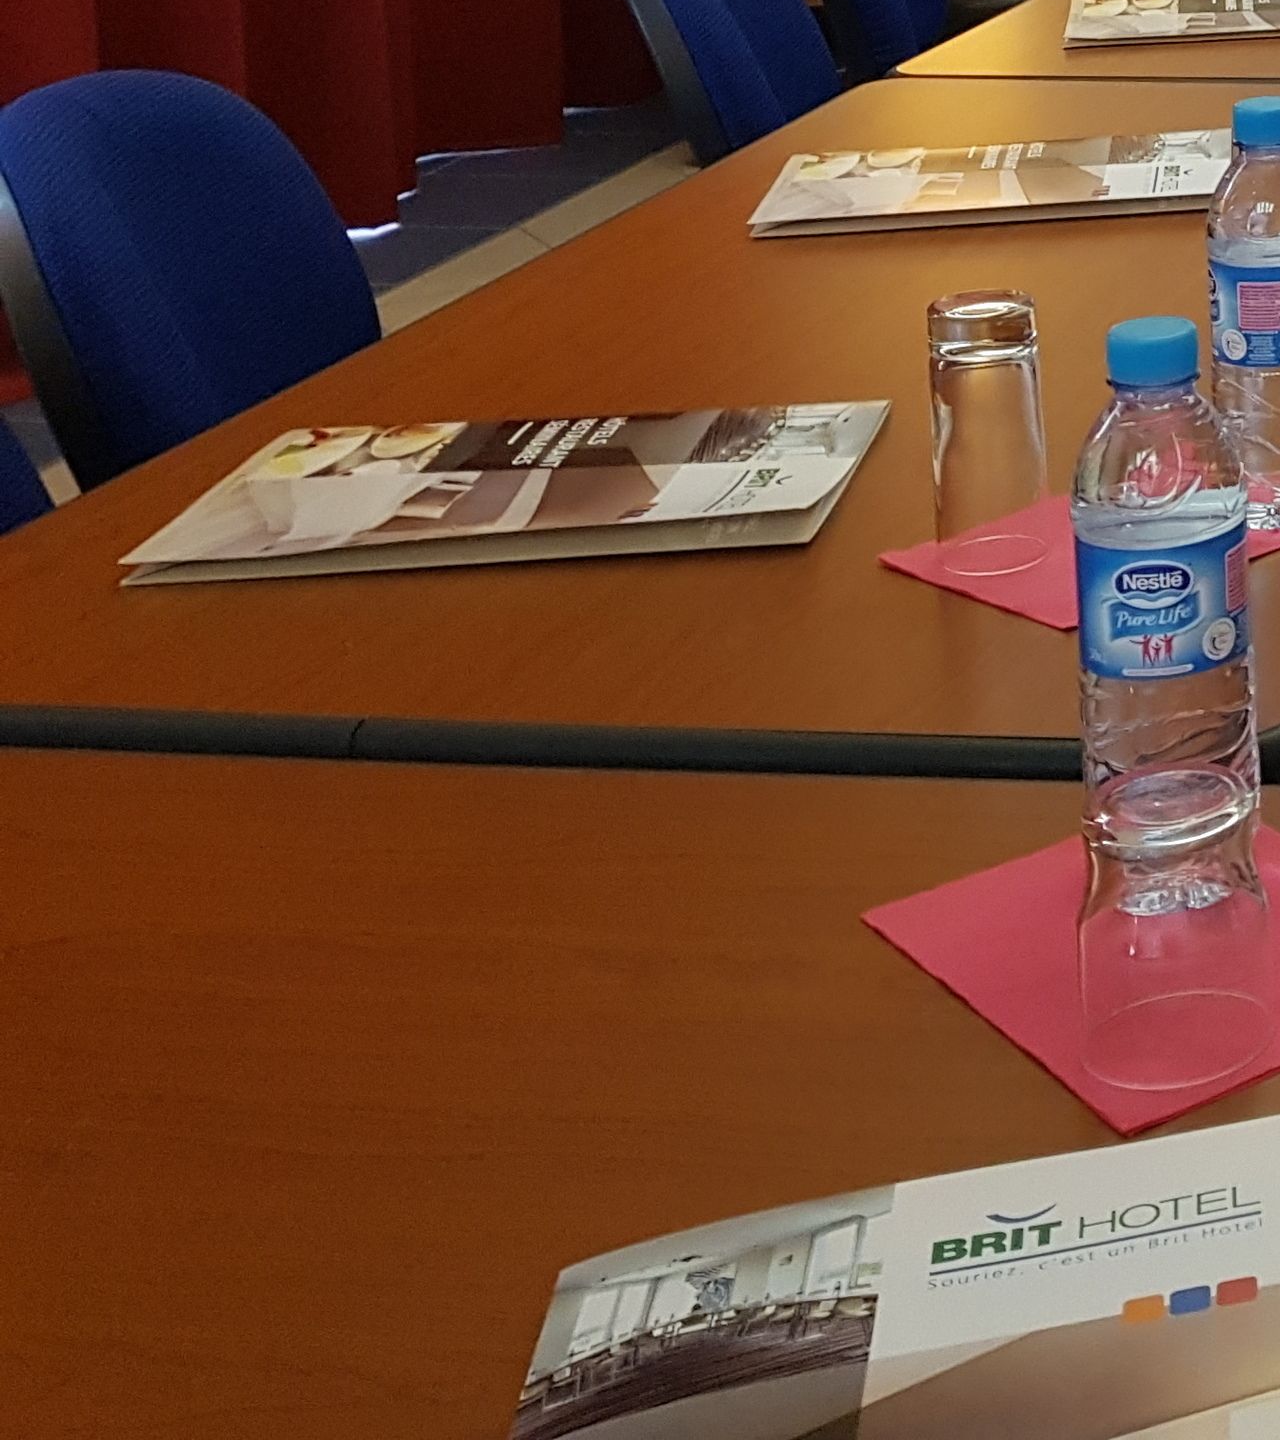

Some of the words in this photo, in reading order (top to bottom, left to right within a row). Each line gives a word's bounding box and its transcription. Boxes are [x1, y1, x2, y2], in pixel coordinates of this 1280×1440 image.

[1122, 571, 1184, 591] Nestlé
[1116, 611, 1157, 629] Pure
[1159, 604, 1193, 625] Life
[931, 1220, 1062, 1265] BRIT
[1078, 1186, 1262, 1239] HOTEL
[1108, 1244, 1135, 1258] un
[1148, 1233, 1189, 1250] Brit
[1201, 1217, 1264, 1240] Hotel
